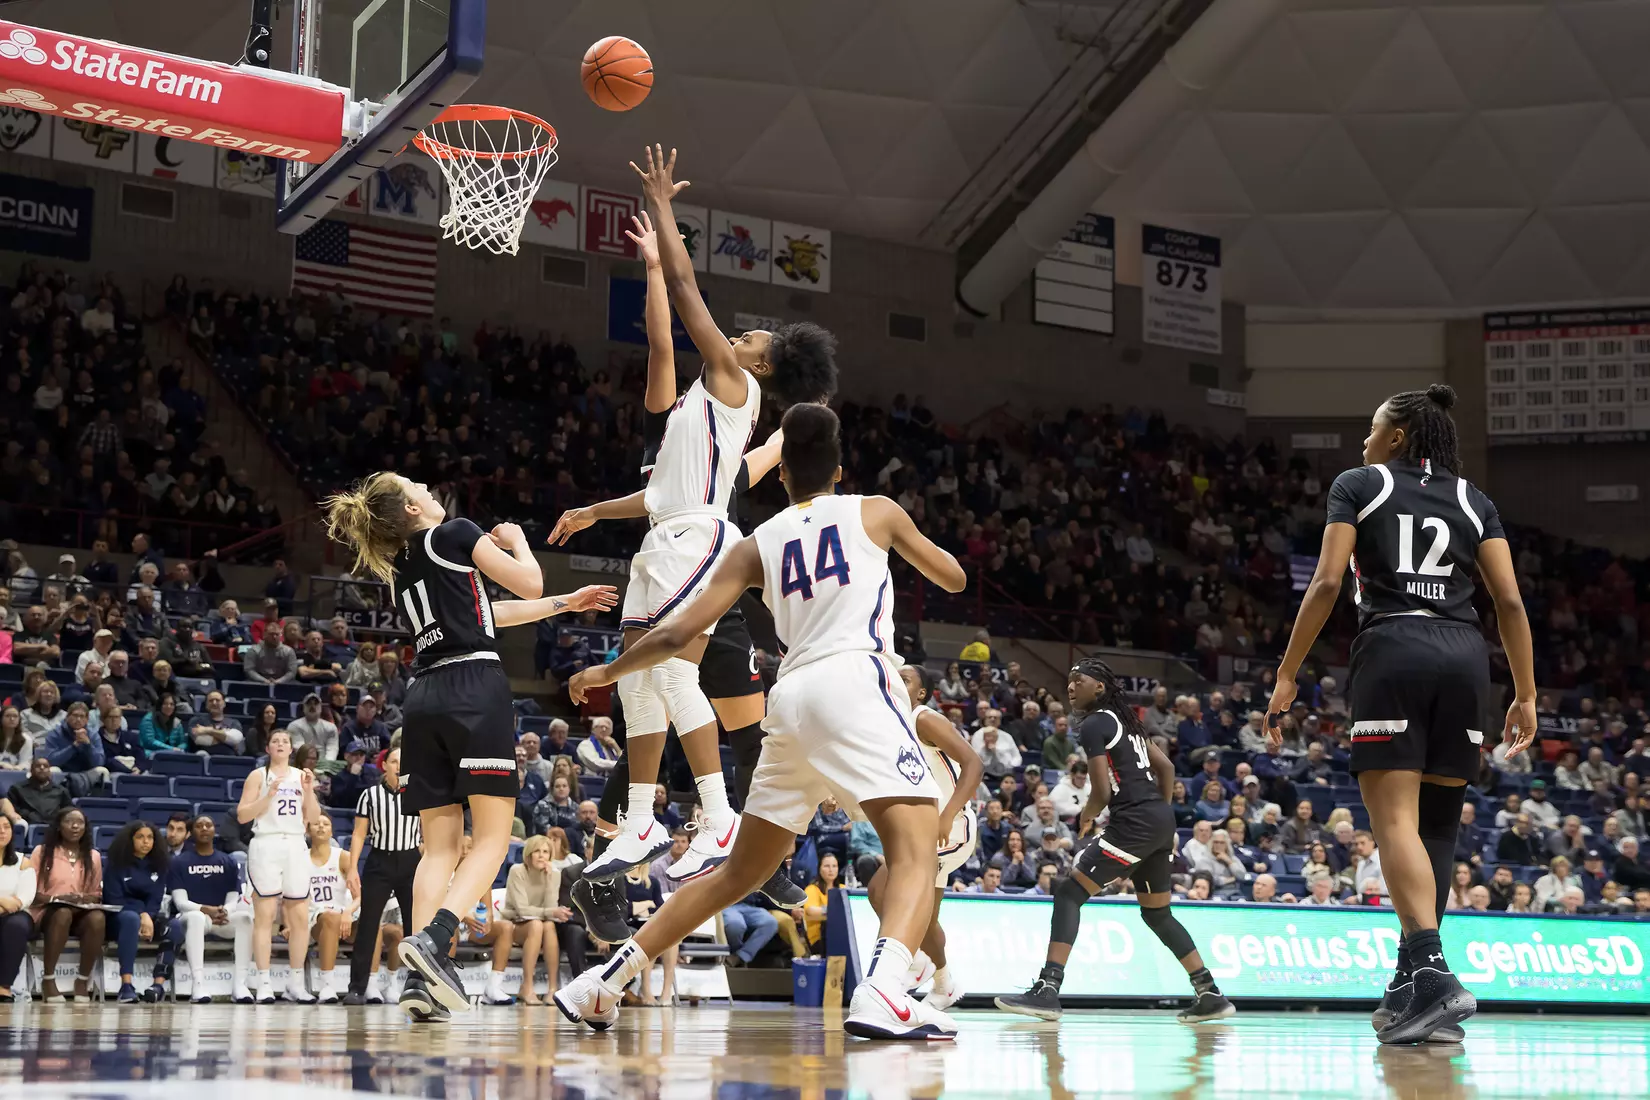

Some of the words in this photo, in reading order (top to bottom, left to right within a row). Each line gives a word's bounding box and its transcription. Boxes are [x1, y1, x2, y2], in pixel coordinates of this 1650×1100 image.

[0, 197, 79, 229] CONN
[1156, 260, 1208, 293] 873
[1396, 513, 1454, 577] 12
[781, 524, 850, 602] 44
[1406, 581, 1446, 600] MILLER
[401, 578, 437, 637] 11
[600, 635, 622, 652] 12
[990, 668, 1009, 684] 21
[278, 799, 297, 816] 25
[188, 865, 225, 875] UCONN
[310, 875, 338, 886] CONN
[313, 886, 333, 903] 20
[1210, 923, 1401, 979] genius3D
[1458, 931, 1645, 984] genius3D
